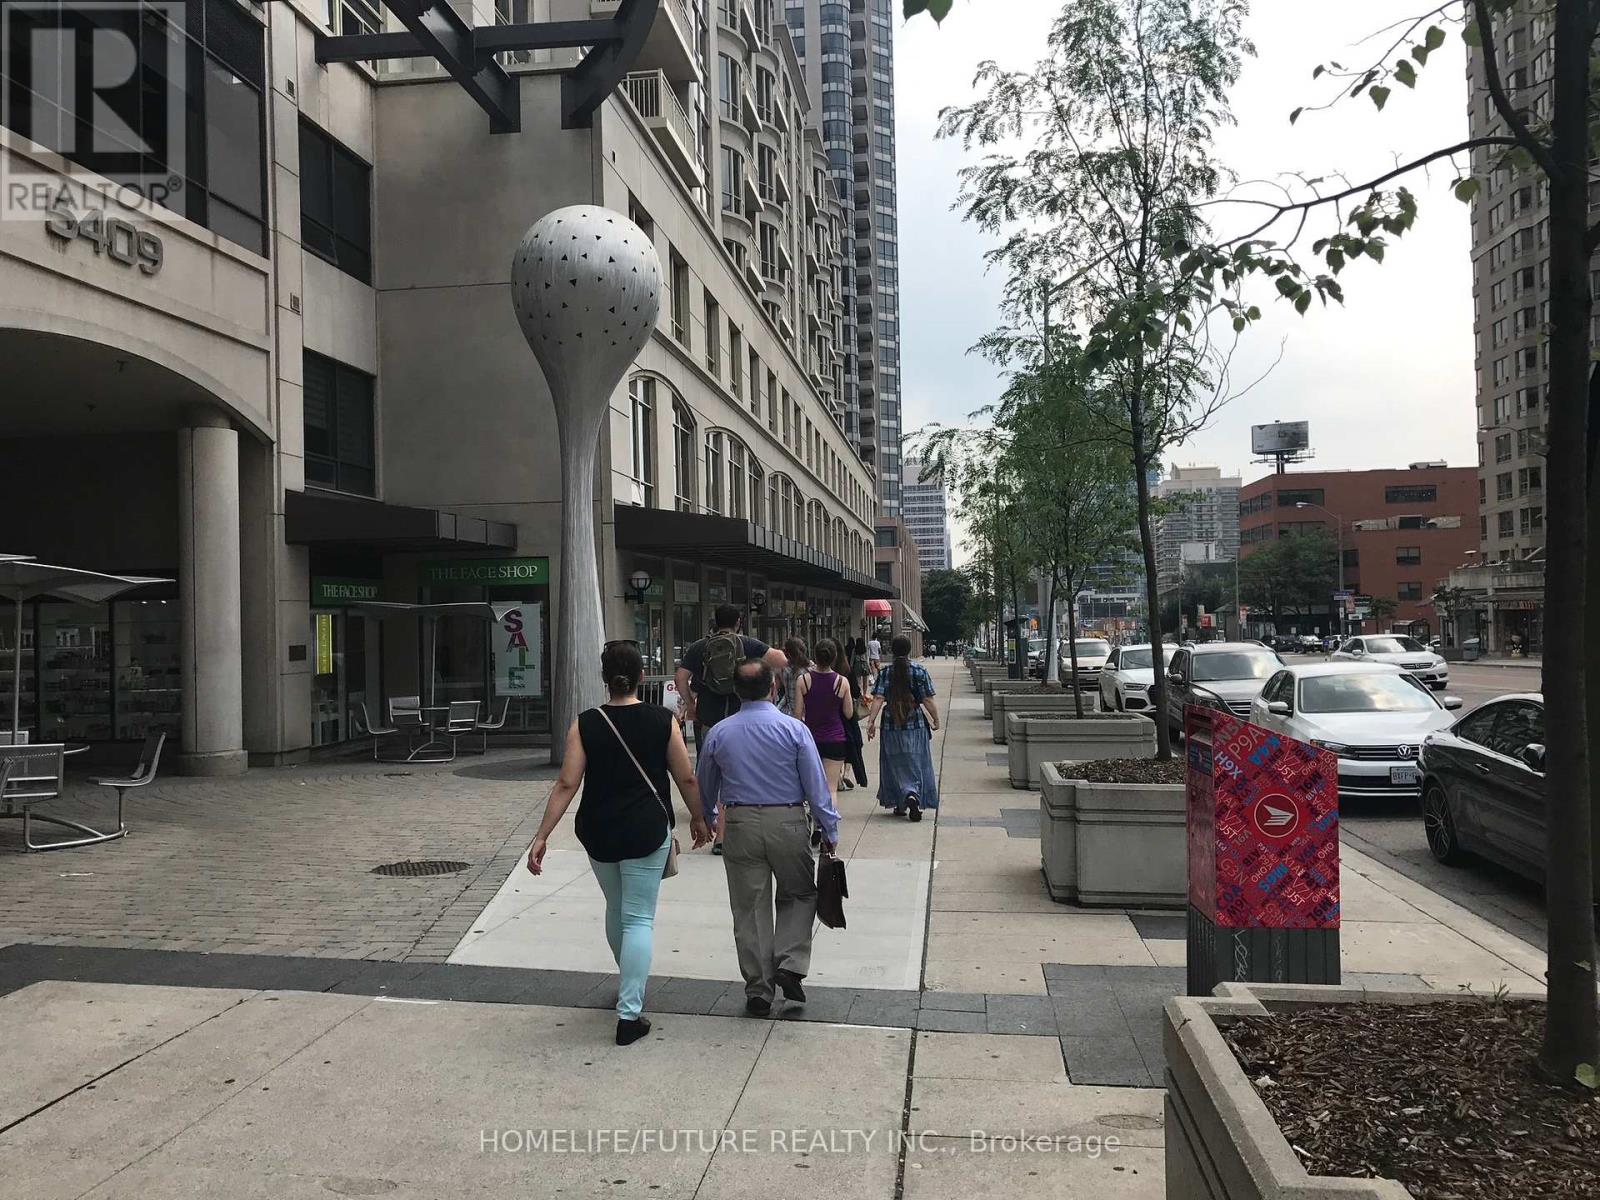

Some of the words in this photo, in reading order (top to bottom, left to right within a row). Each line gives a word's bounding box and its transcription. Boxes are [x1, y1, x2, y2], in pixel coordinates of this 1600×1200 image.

[45, 207, 164, 274] 3409
[504, 609, 535, 689] SALE
[1228, 726, 1265, 760] P9A
[1214, 751, 1243, 780] H9X
[1278, 764, 1297, 780] J5T
[1220, 824, 1238, 839] J5T
[1287, 891, 1306, 906] J5T
